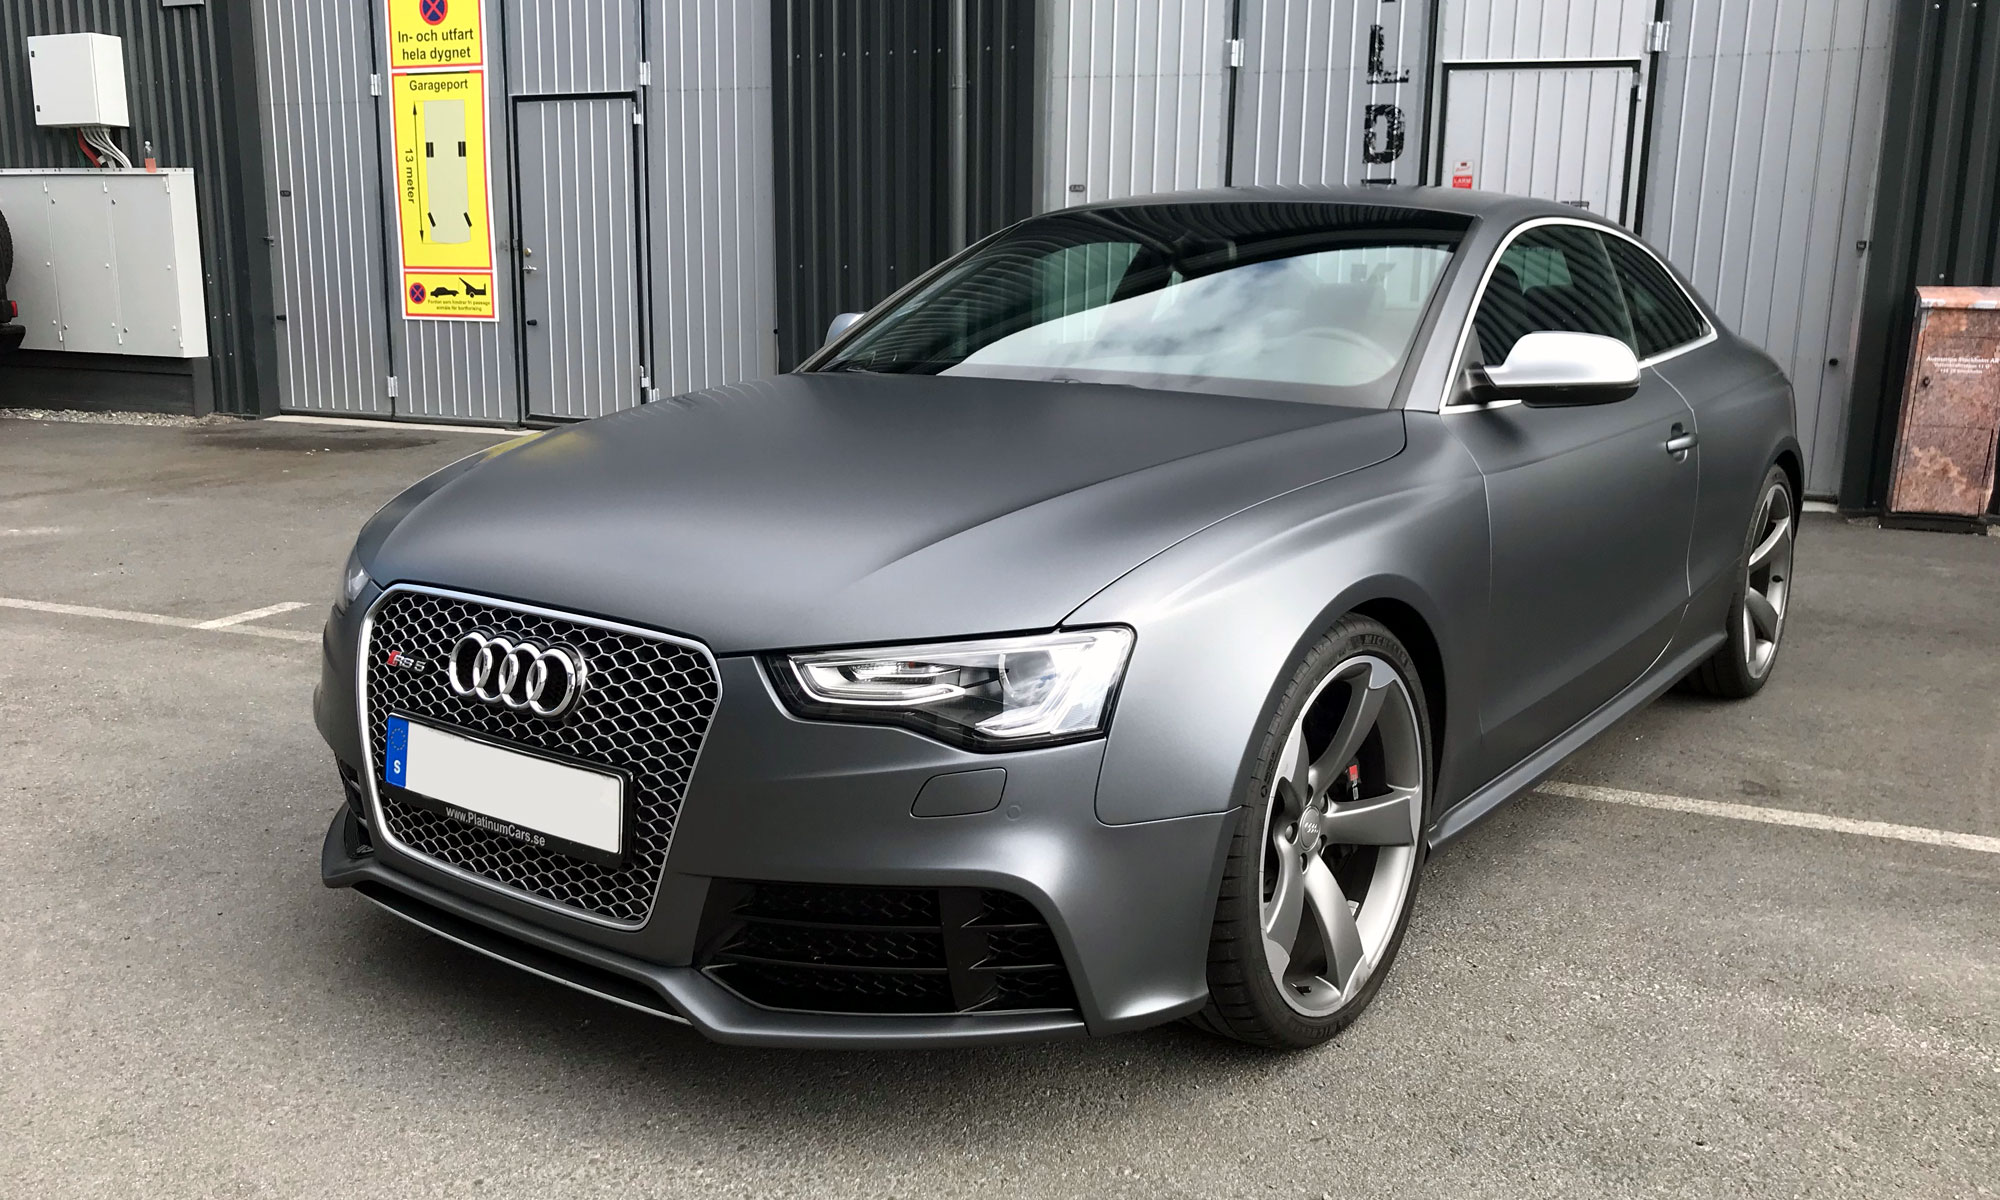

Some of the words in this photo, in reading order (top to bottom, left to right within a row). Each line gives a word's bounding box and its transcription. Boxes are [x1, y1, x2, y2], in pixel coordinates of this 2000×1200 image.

[398, 31, 413, 43] In-
[416, 29, 438, 42] och
[442, 28, 474, 41] utfart
[402, 48, 426, 60] hela
[430, 46, 471, 62] dygnet
[409, 79, 468, 93] Garageport
[405, 148, 414, 163] 13
[406, 167, 415, 204] meter
[393, 654, 414, 669] RS
[414, 660, 426, 672] 5
[393, 759, 402, 775] S
[445, 806, 546, 847] www.PlatinumCars.se
